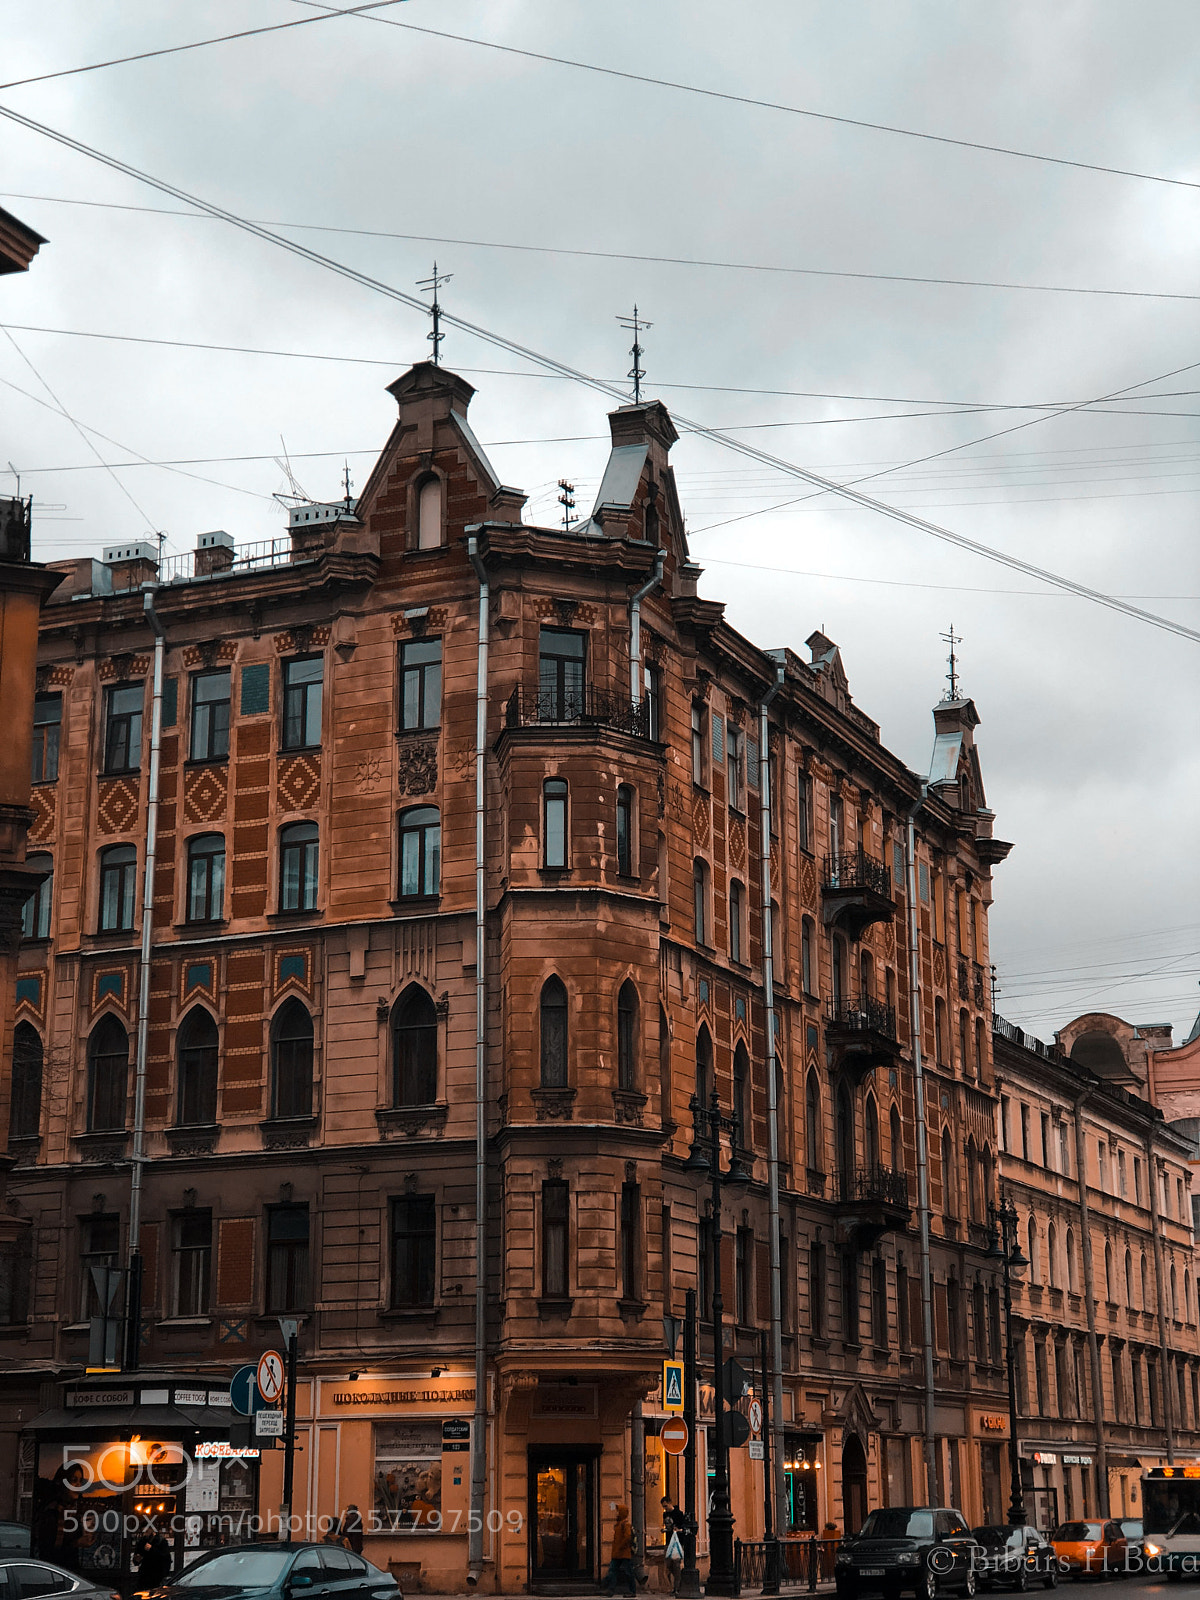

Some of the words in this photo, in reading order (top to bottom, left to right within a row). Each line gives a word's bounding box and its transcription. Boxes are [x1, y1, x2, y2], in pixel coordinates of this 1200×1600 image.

[73, 1394, 94, 1404] КОФЕ
[95, 1394, 101, 1402] С
[102, 1392, 129, 1402] СОБОЙ
